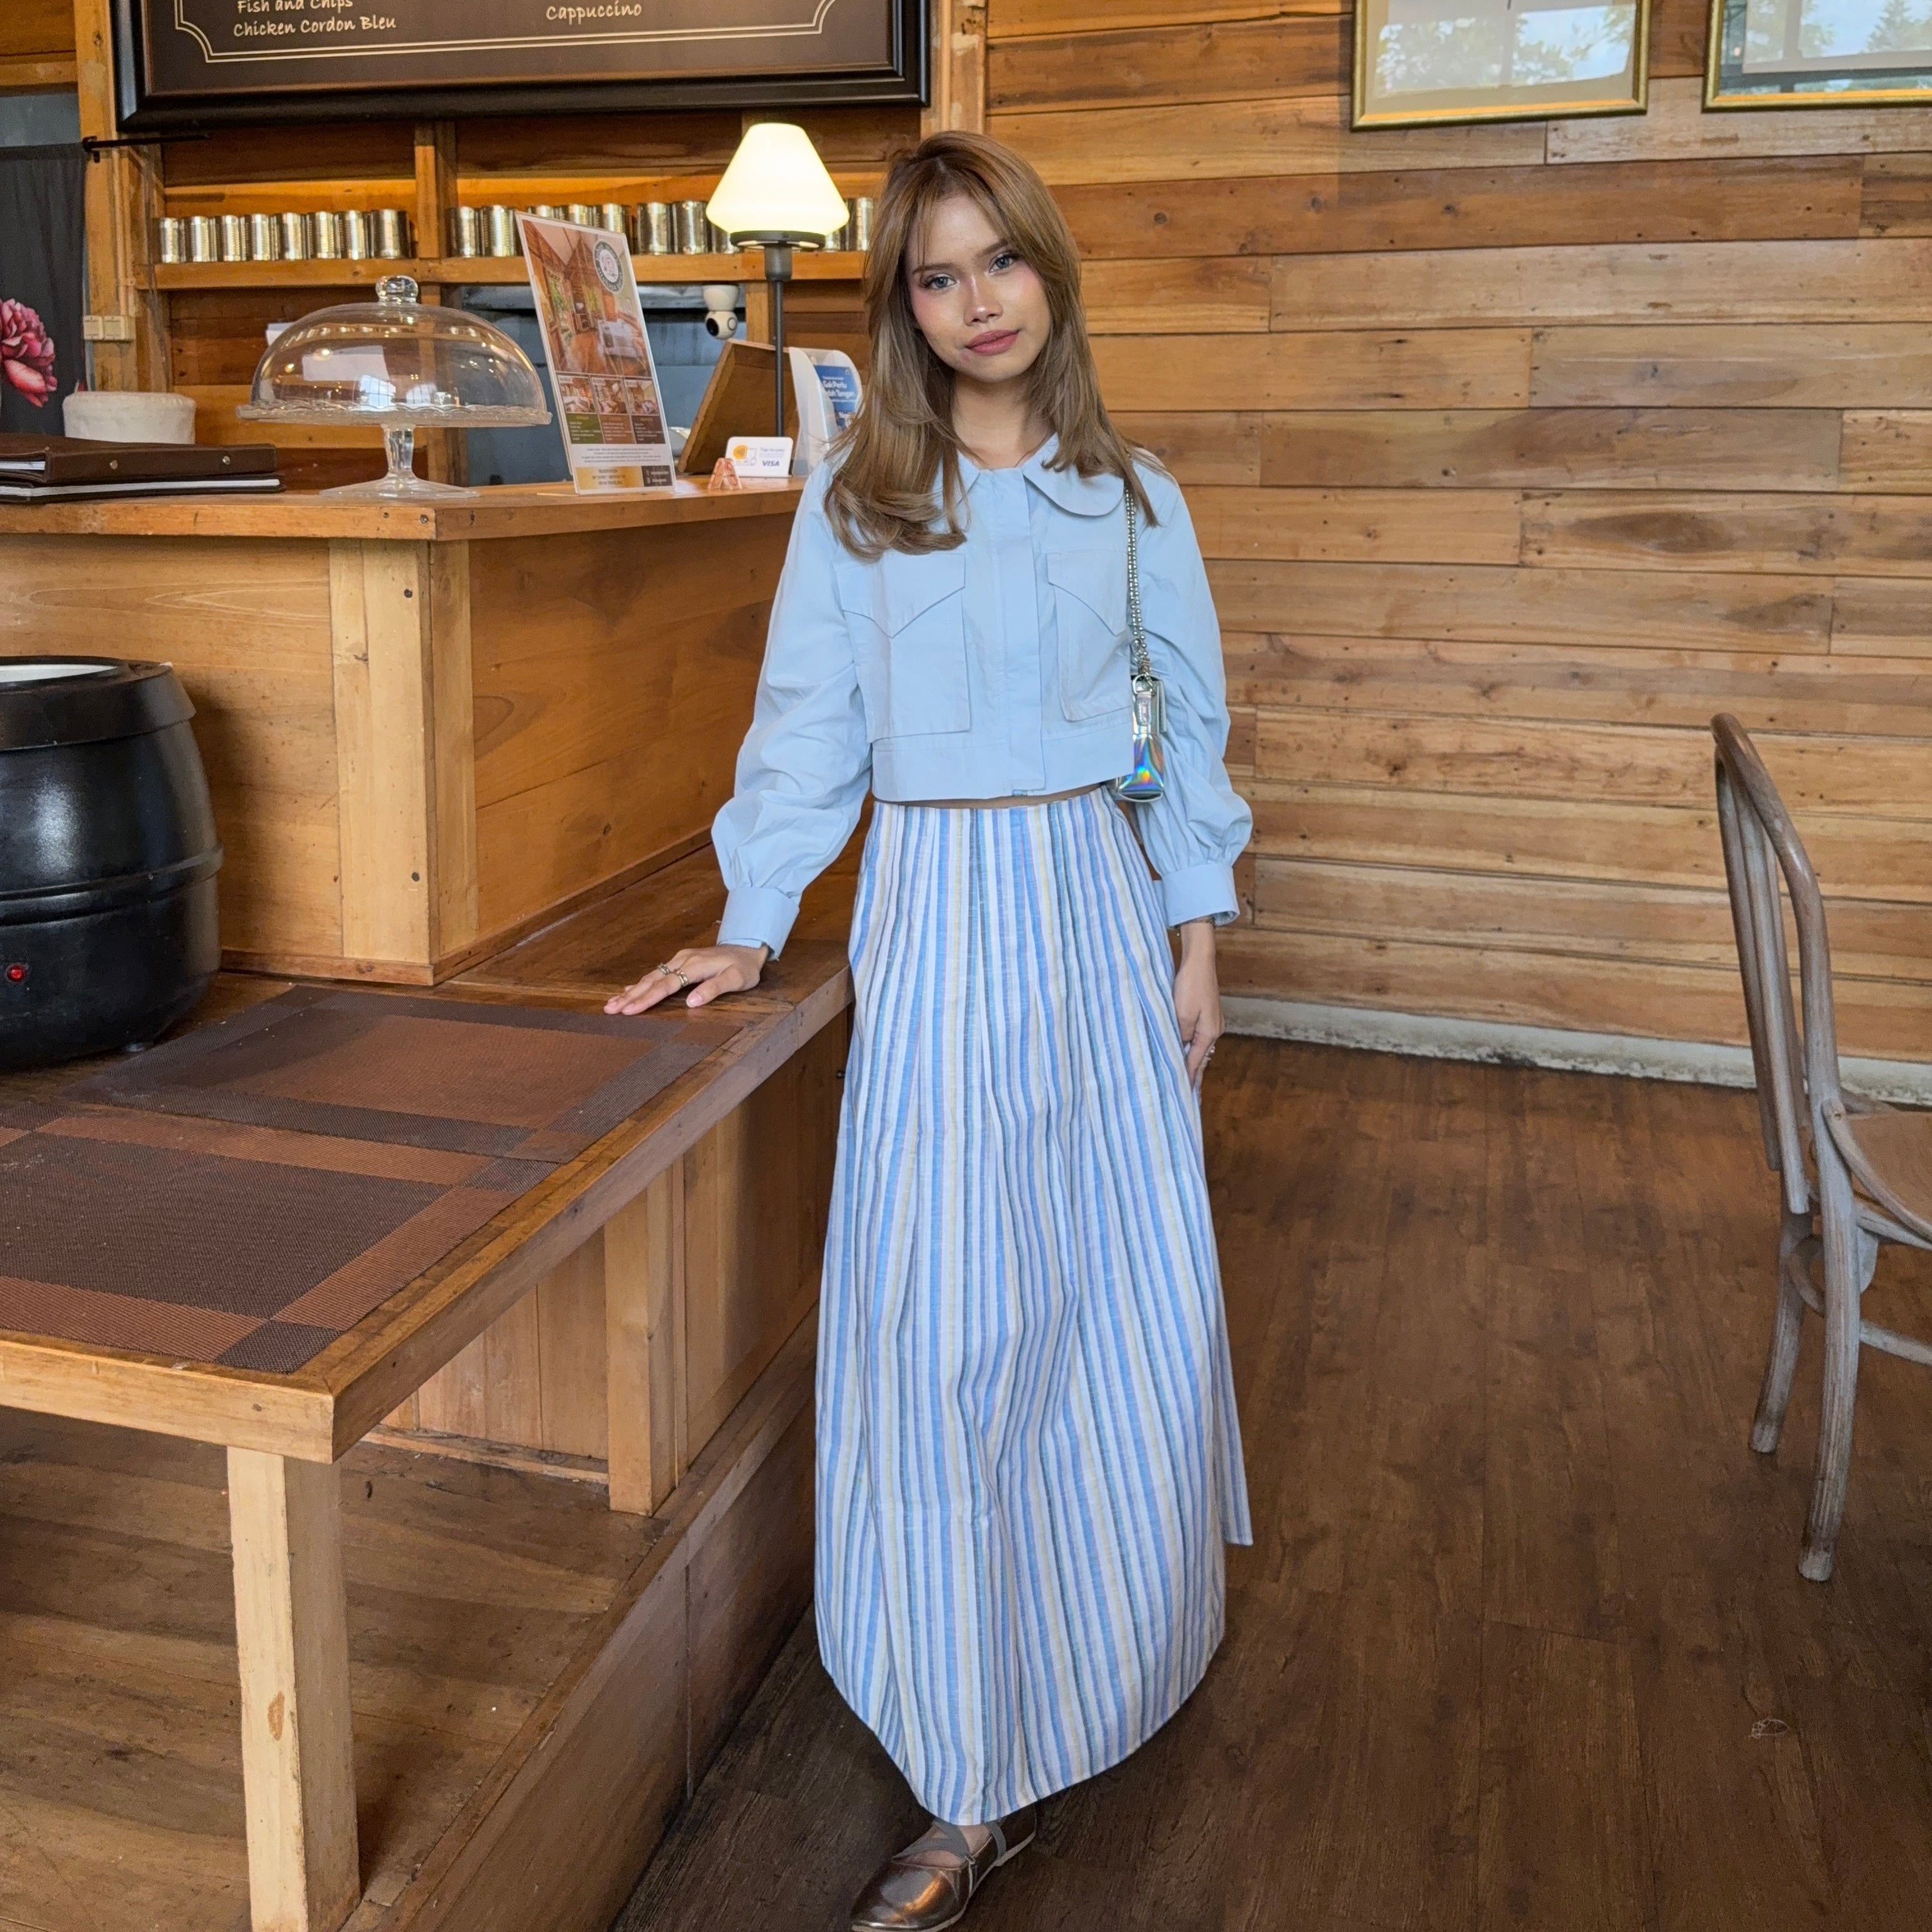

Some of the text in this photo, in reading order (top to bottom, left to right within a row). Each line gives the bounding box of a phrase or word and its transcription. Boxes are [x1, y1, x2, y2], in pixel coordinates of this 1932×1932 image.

[237, 0, 270, 13] Fish
[275, 0, 304, 11] and
[546, 0, 642, 25] Cappuccino
[233, 14, 397, 37] Chicken Cordon Bleu
